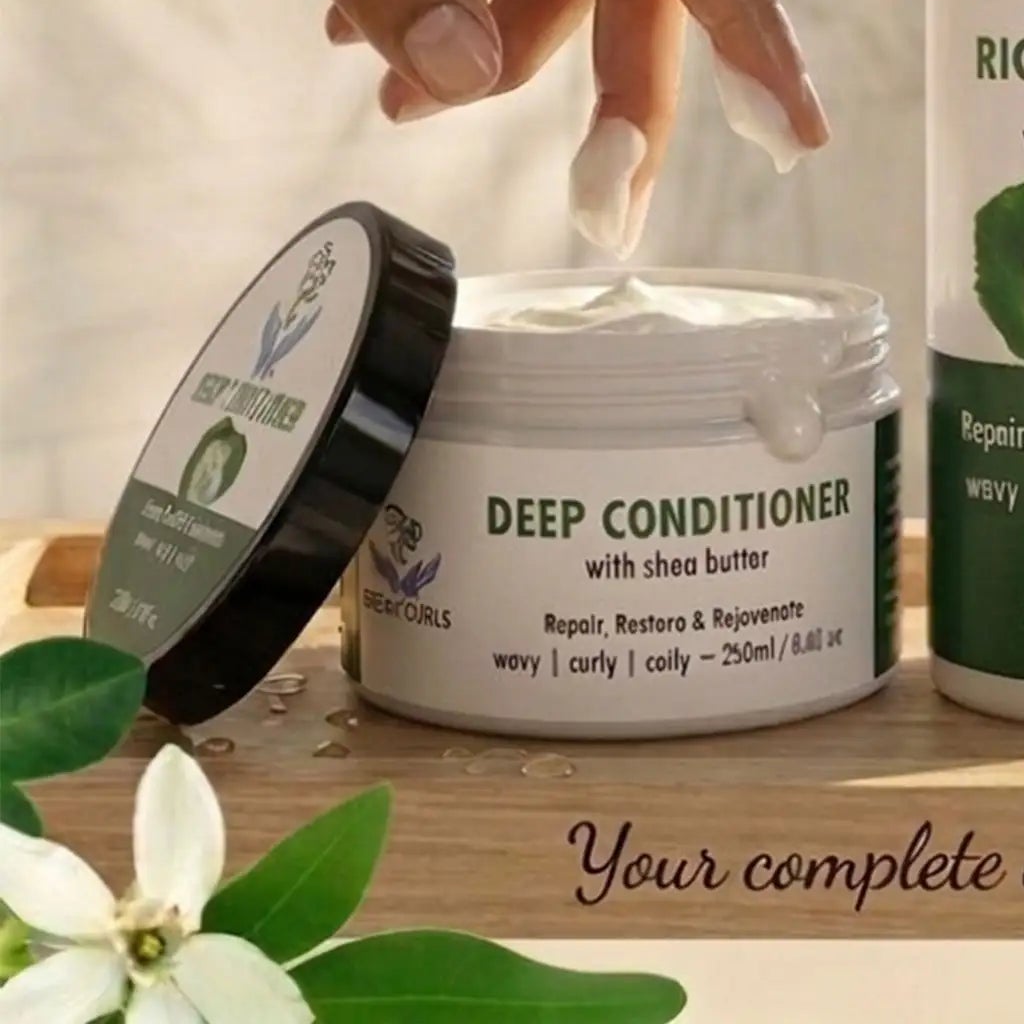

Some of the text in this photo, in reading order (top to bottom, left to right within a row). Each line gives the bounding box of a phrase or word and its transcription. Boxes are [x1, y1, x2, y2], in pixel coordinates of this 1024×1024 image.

[486, 478, 851, 539] DEEP CONDITIONER
[585, 551, 635, 580] with
[643, 550, 697, 579] shea
[692, 610, 706, 631] &
[569, 649, 618, 679] curly
[645, 646, 690, 677] coily
